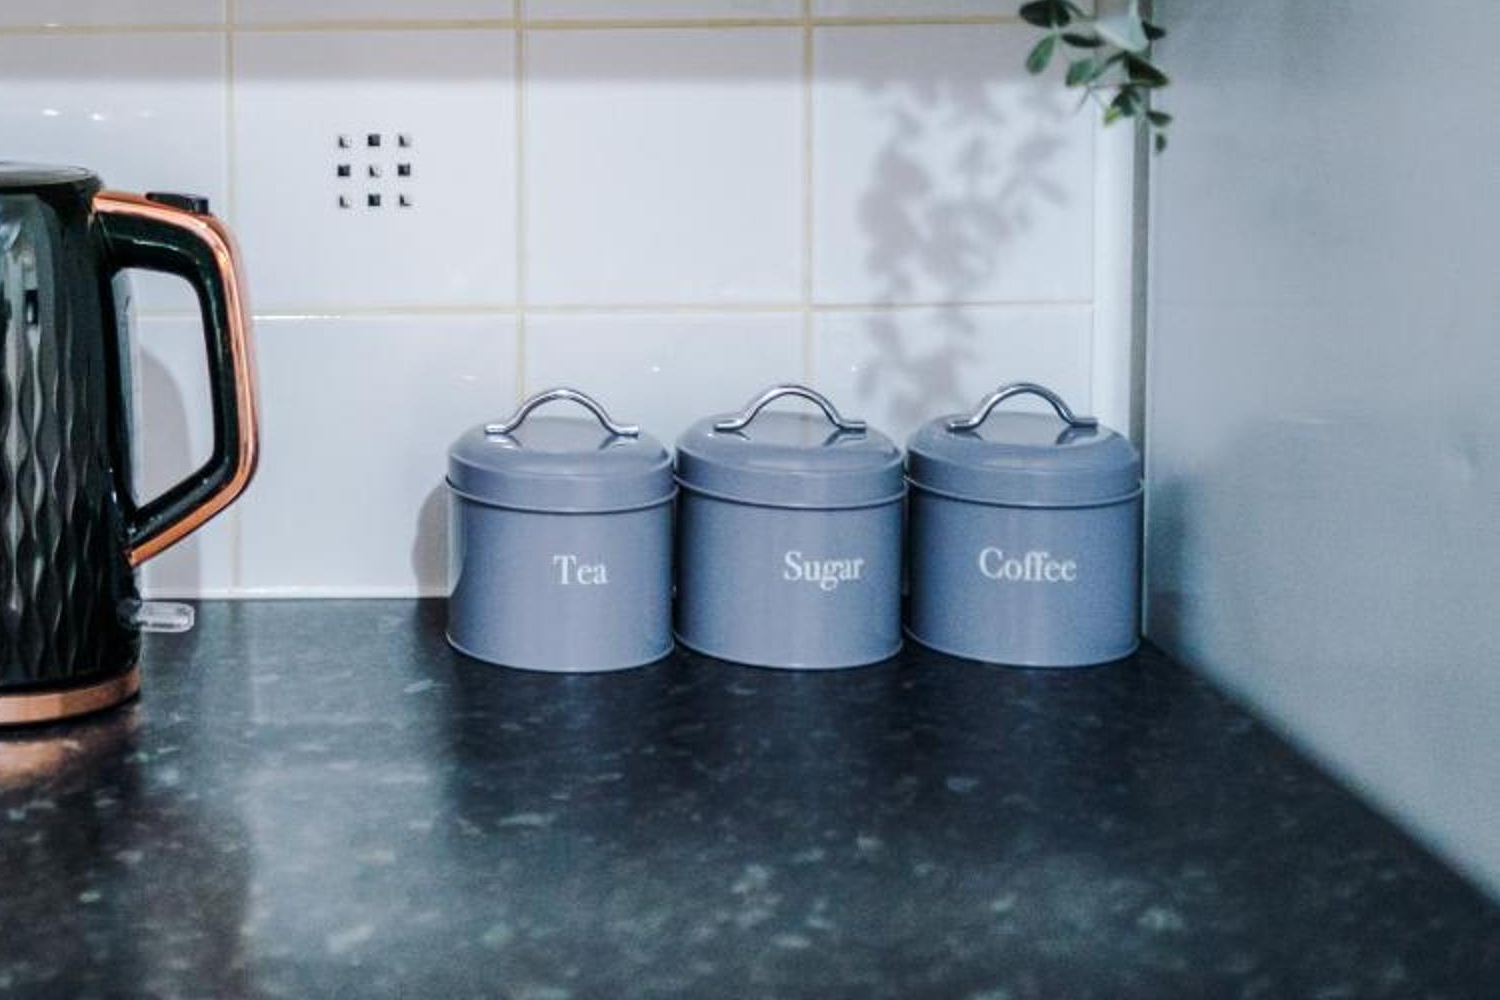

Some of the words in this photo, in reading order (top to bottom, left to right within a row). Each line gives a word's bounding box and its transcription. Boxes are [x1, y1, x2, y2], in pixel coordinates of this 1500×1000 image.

[553, 554, 608, 585] Tea
[783, 550, 864, 591] Sugar
[978, 546, 1077, 582] Coffee
